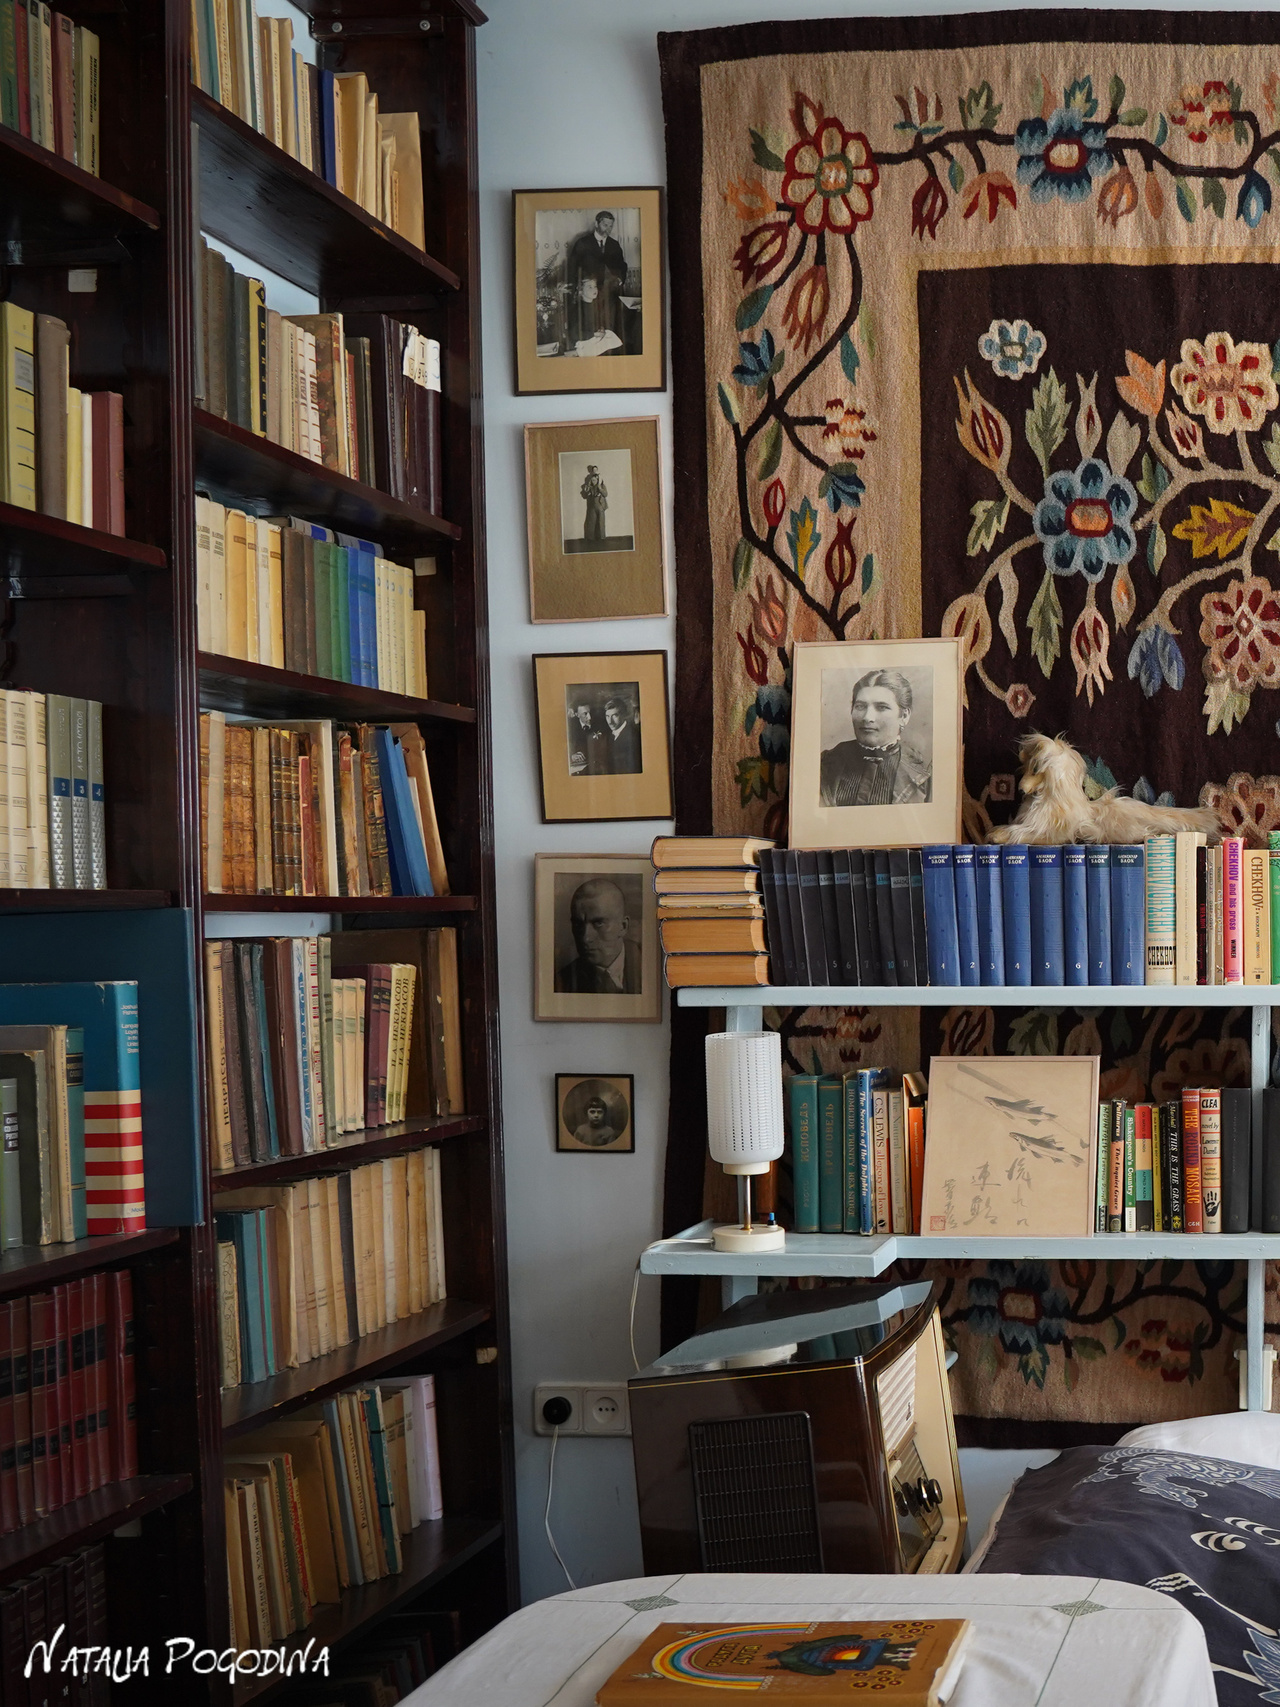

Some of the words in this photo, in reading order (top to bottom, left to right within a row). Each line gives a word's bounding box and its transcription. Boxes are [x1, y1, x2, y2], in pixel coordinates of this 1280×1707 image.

[1228, 842, 1239, 881] CHEKHOV
[1229, 883, 1237, 895] and
[1251, 857, 1264, 911] CHEKHOV:
[1229, 898, 1237, 908] his
[1227, 910, 1237, 931] prose
[888, 961, 896, 969] 10
[298, 979, 309, 1075] НЕКРАСОВ
[220, 1046, 230, 1126] НЕКРАСОВ
[892, 1094, 901, 1113] The
[1201, 1097, 1218, 1108] CLEA
[1184, 1108, 1198, 1129] THE
[799, 1102, 809, 1162] ИСПОВЕДЬ
[893, 1116, 902, 1150] Natural
[1126, 1117, 1134, 1165] Shakespeare's
[1170, 1132, 1178, 1151] THIS
[1171, 1155, 1178, 1163] IS
[1185, 1131, 1199, 1166] ROUND
[875, 1150, 885, 1185] allegory
[1171, 1166, 1179, 1184] THE
[877, 1186, 886, 1195] of
[1126, 1167, 1135, 1196] Country
[1185, 1167, 1200, 1204] MOSAIC
[877, 1197, 886, 1216] love
[1172, 1187, 1180, 1212] GRASS
